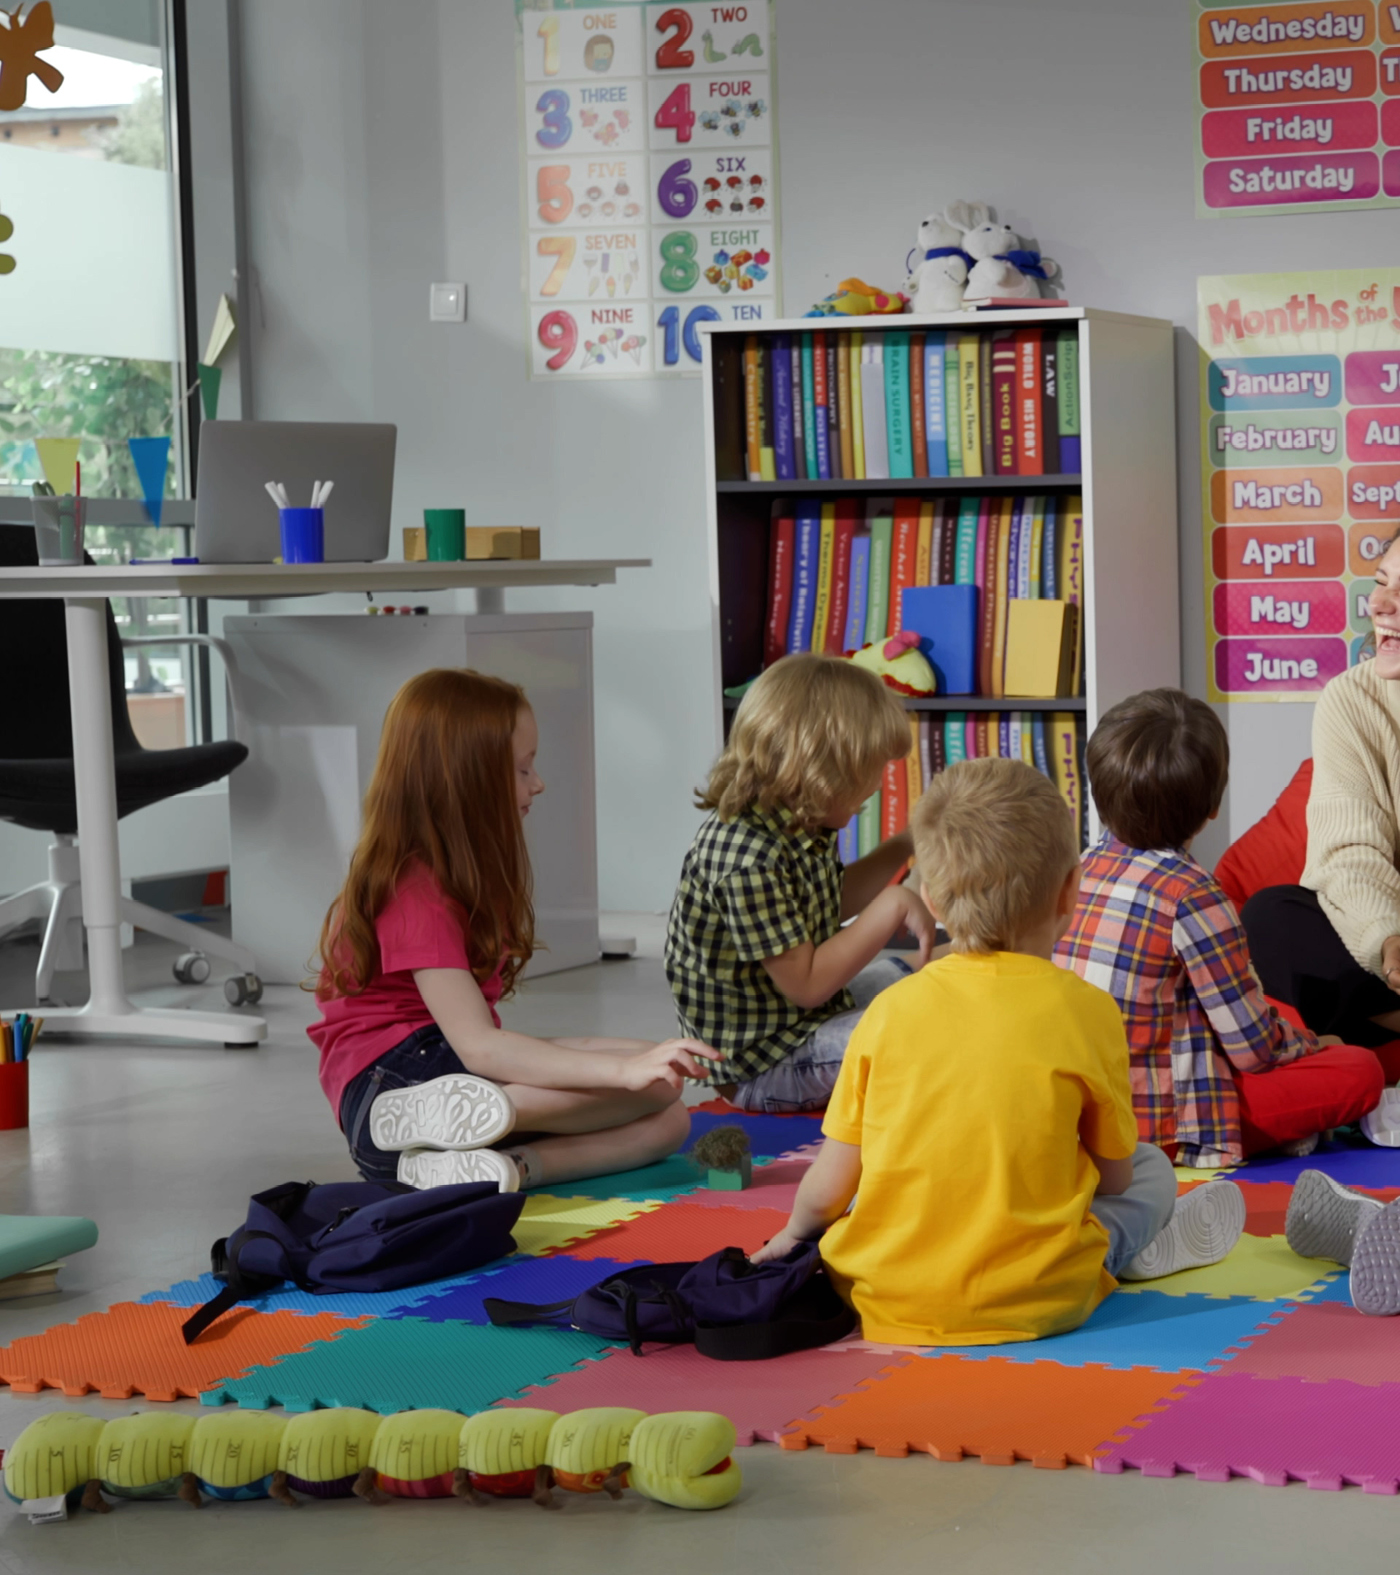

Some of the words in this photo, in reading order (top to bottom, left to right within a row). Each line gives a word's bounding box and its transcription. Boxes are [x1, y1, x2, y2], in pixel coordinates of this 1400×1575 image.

[583, 14, 617, 30] ONE
[711, 7, 747, 23] TWO
[1210, 13, 1365, 45] Wednesday
[537, 15, 560, 75] 1
[655, 8, 694, 69] 2
[709, 81, 752, 97] FOUR
[1224, 64, 1353, 93] Thursday
[580, 87, 627, 103] THREE
[536, 89, 573, 150] 3
[655, 83, 695, 143] 4
[1246, 115, 1333, 144] Friday
[588, 163, 626, 178] FIVE
[716, 157, 746, 172] SIX
[1229, 164, 1354, 193] Saturday
[537, 165, 574, 224] 5
[658, 158, 698, 218] 6
[585, 235, 636, 249] SEVEN
[711, 230, 759, 246] EIGHT
[537, 236, 576, 296] 7
[660, 231, 700, 292] 8
[1359, 283, 1378, 302] of
[592, 309, 633, 324] NINE
[732, 305, 762, 320] TEN
[1207, 294, 1350, 346] Months
[1355, 305, 1388, 326] the
[538, 310, 578, 370] 9
[890, 340, 901, 386] BRAIN
[1022, 342, 1035, 390] WORLD
[1045, 354, 1056, 398] LAW
[929, 354, 942, 434] MEDICINE
[964, 383, 976, 411] Bang
[1220, 369, 1331, 398] January
[891, 389, 903, 456] SURGERY
[1000, 383, 1012, 431] Book
[966, 414, 977, 452] Theory
[1023, 399, 1037, 459] HISTORY
[1217, 425, 1337, 454] February
[1002, 434, 1014, 468] Big
[1233, 480, 1322, 509] March
[1242, 537, 1316, 575] April
[832, 580, 845, 636] Analysis
[1250, 594, 1310, 628] May
[1244, 652, 1318, 683] June
[228, 1442, 240, 1459] 20
[346, 1441, 358, 1458] 30
